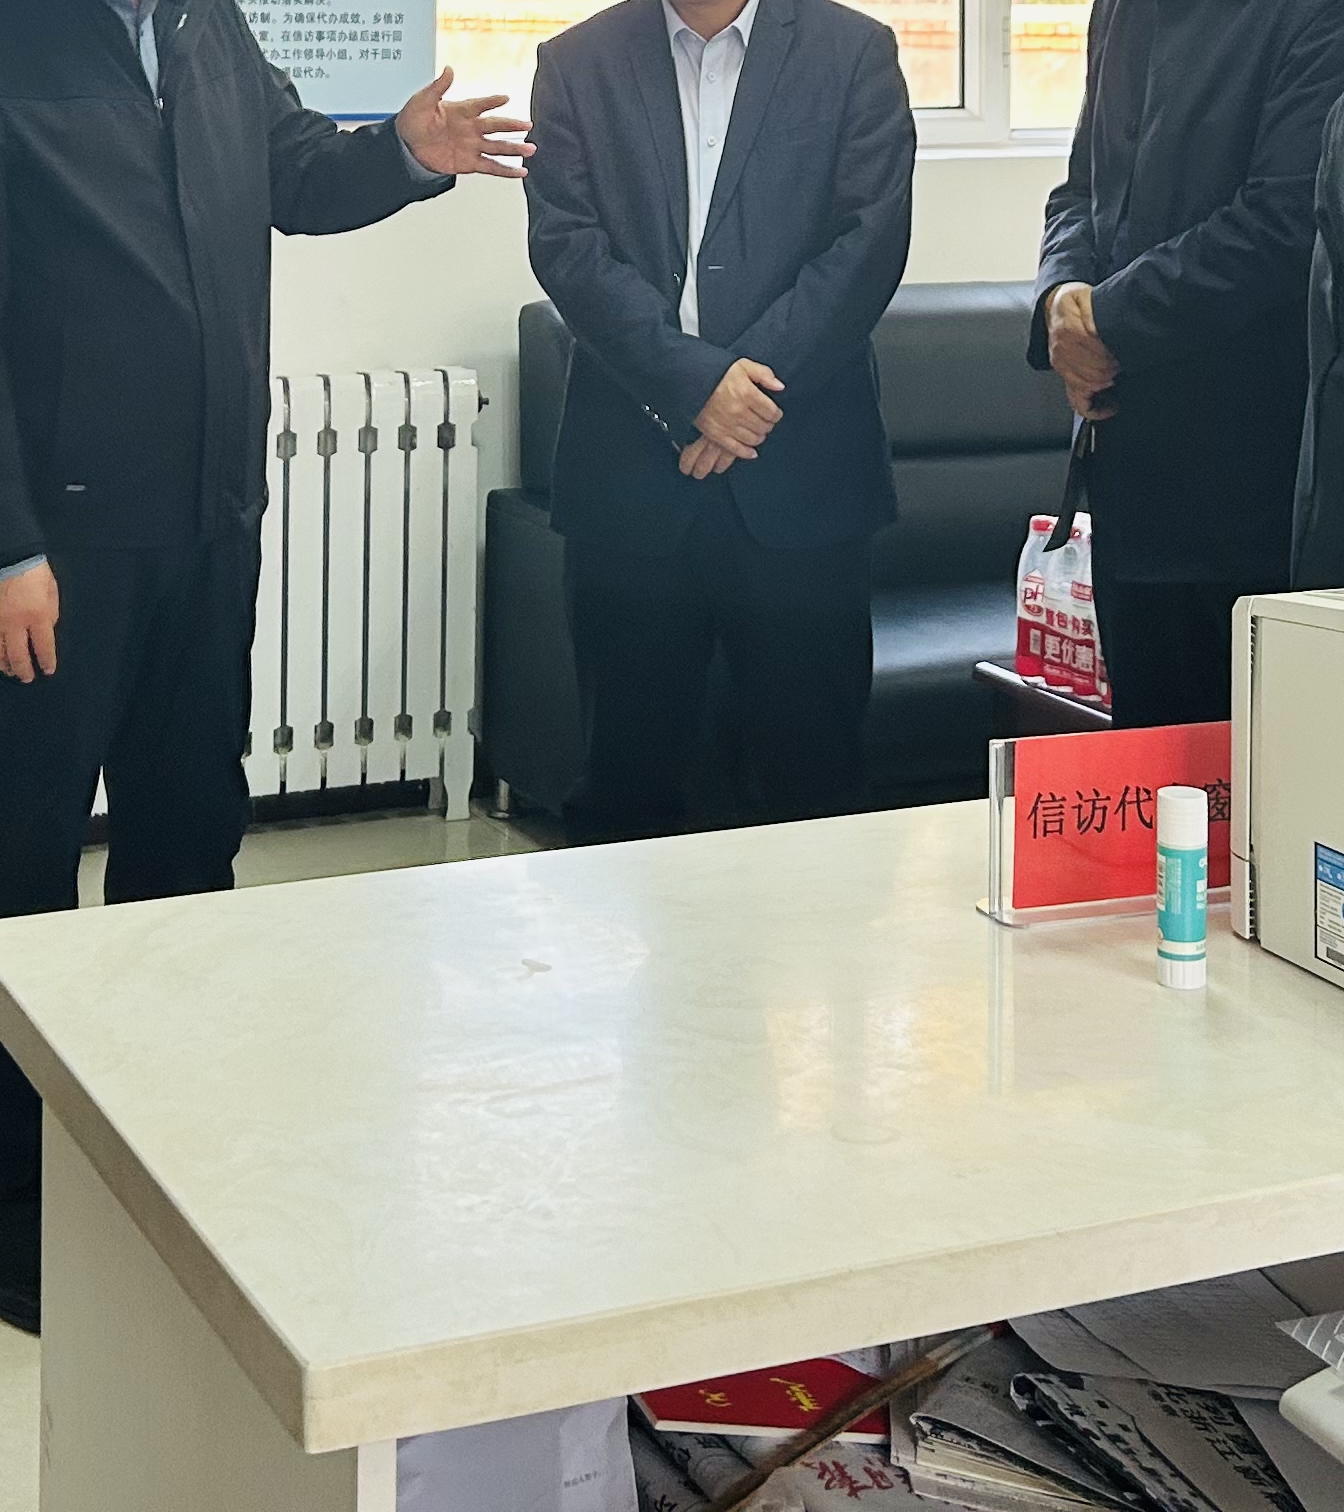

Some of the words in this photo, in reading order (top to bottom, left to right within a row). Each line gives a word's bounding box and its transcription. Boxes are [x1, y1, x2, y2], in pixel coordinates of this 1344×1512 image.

[1044, 634, 1094, 674] 更优惠
[1027, 779, 1230, 839] 信访代窗
